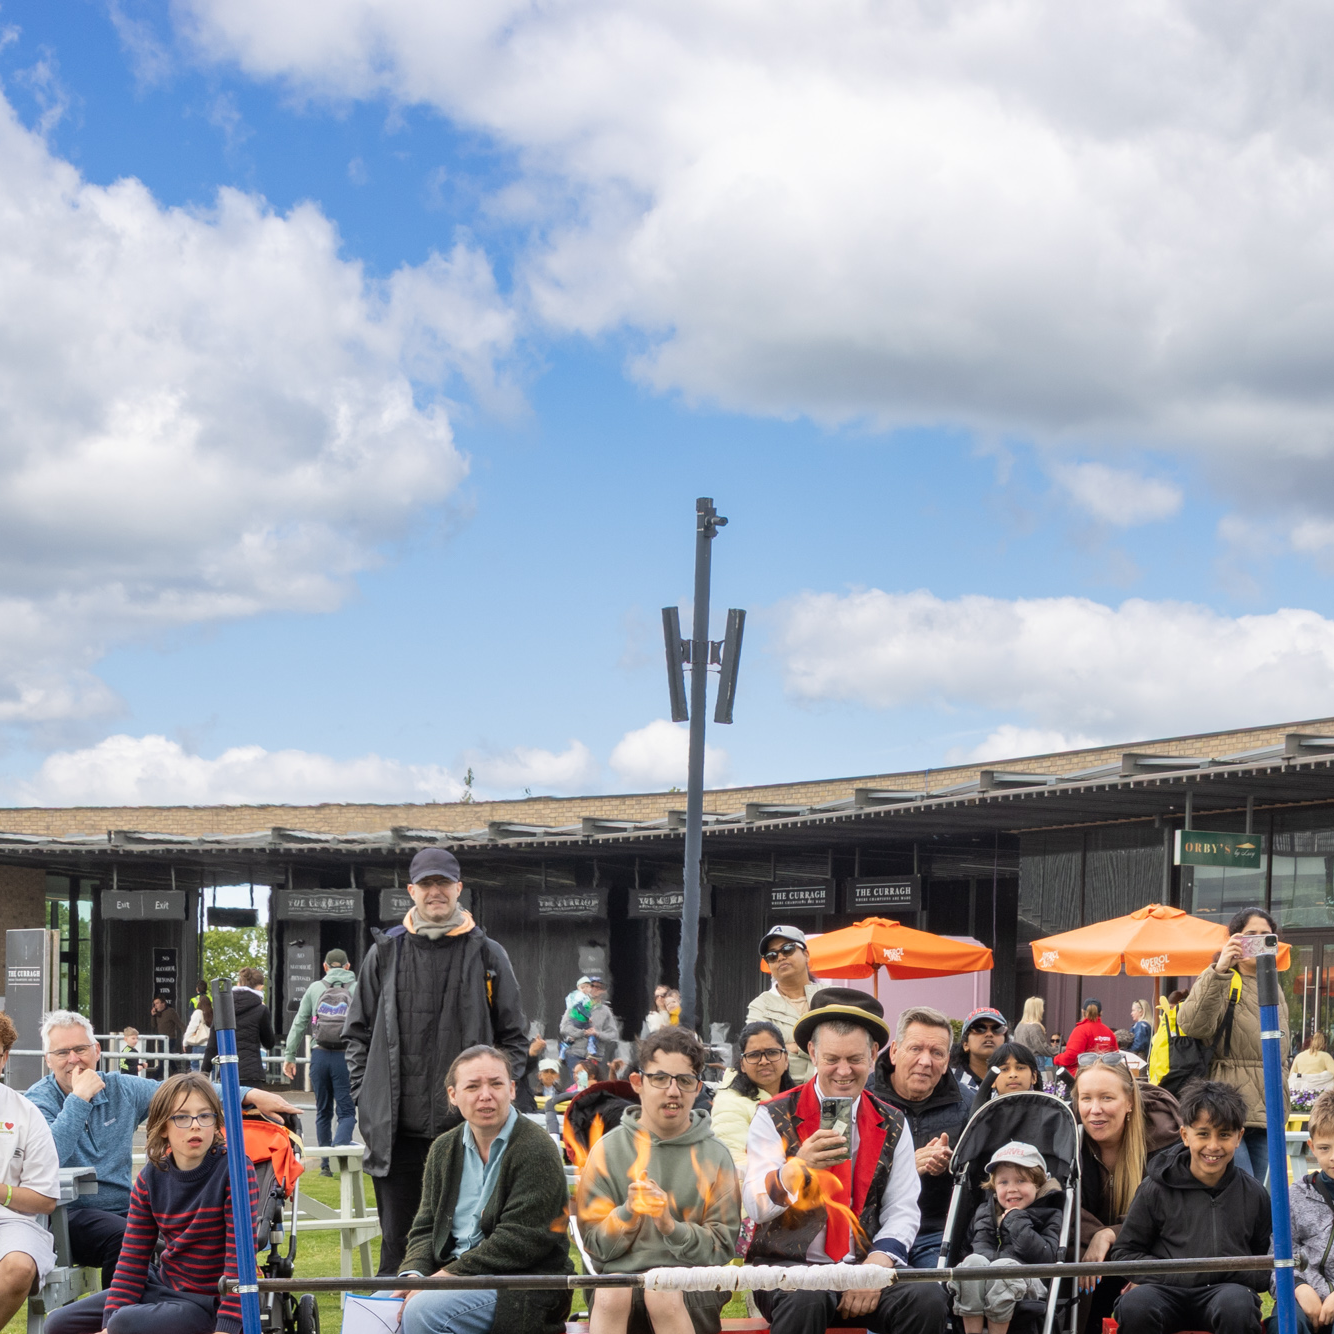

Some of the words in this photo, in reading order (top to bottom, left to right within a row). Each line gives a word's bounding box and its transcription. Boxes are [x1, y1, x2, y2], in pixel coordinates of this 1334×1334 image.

[1185, 842, 1231, 854] ORBY'S
[771, 892, 787, 900] THE
[789, 890, 826, 899] CURRAGH
[856, 888, 871, 897] THE
[873, 887, 911, 896] CURRAGH
[117, 901, 130, 910] Exit
[155, 901, 169, 910] Exit
[772, 926, 783, 934] A
[1140, 954, 1169, 970] APEROL
